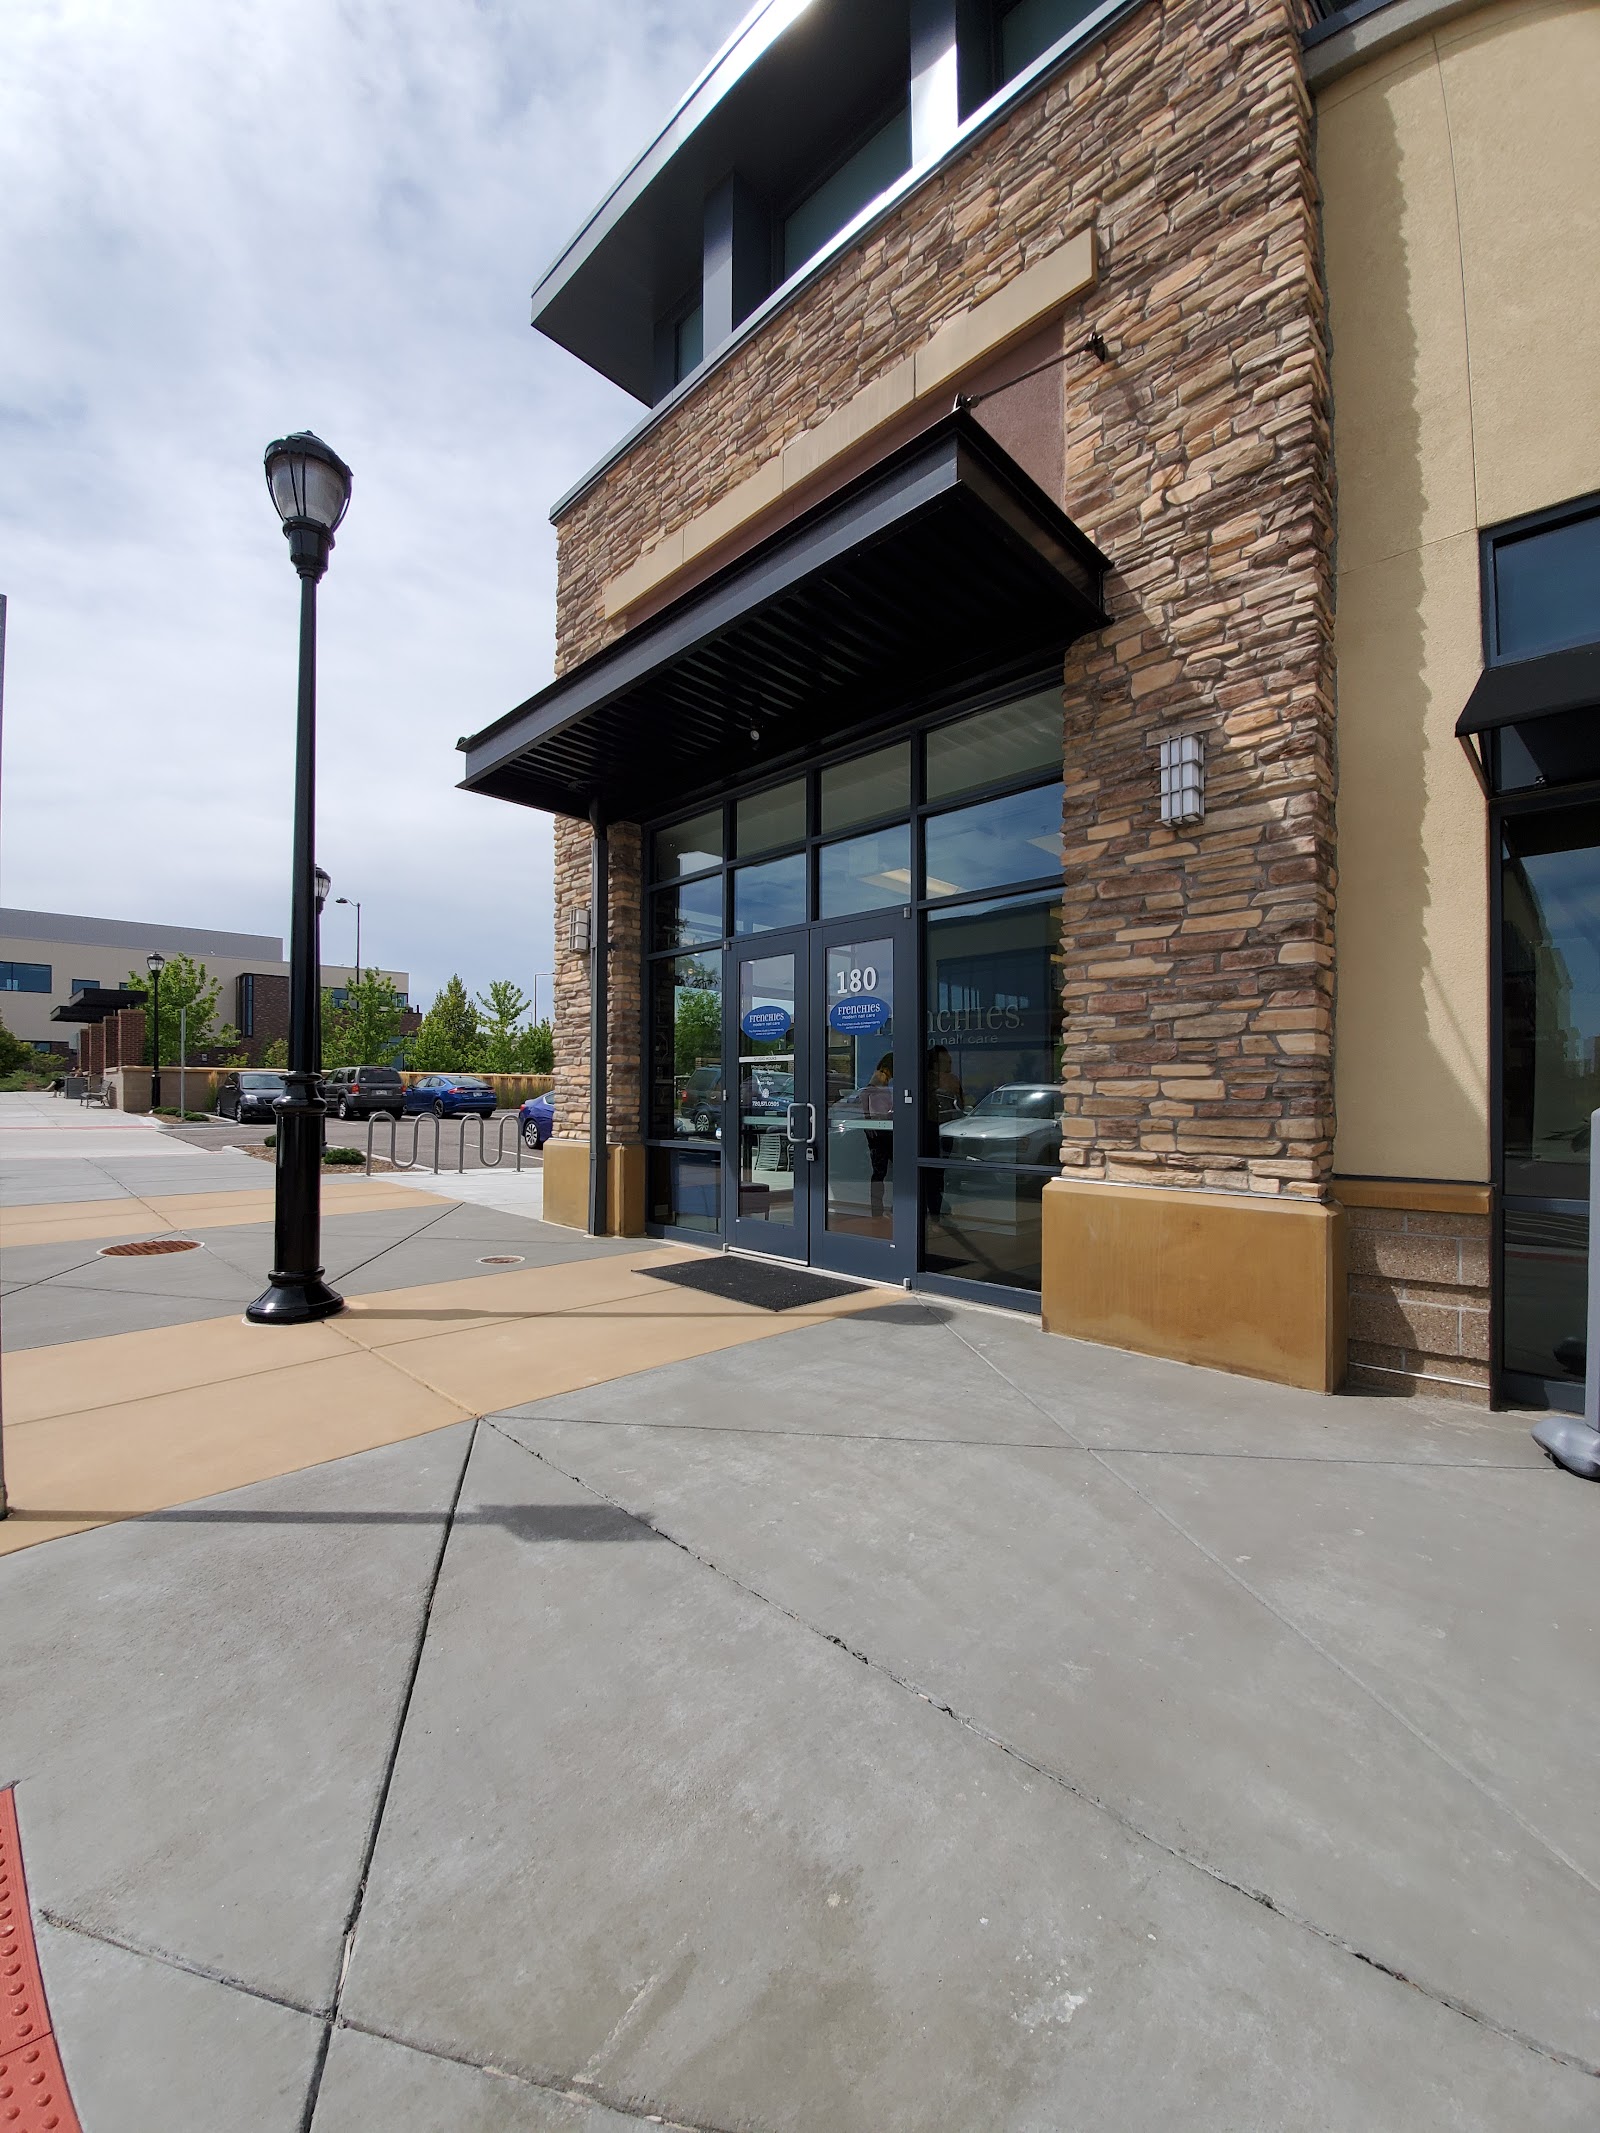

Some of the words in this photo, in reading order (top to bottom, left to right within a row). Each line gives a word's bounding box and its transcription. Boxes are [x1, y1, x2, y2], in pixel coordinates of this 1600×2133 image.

[836, 966, 877, 994] 180
[940, 1034, 963, 1045] nail
[968, 1034, 999, 1044] care
